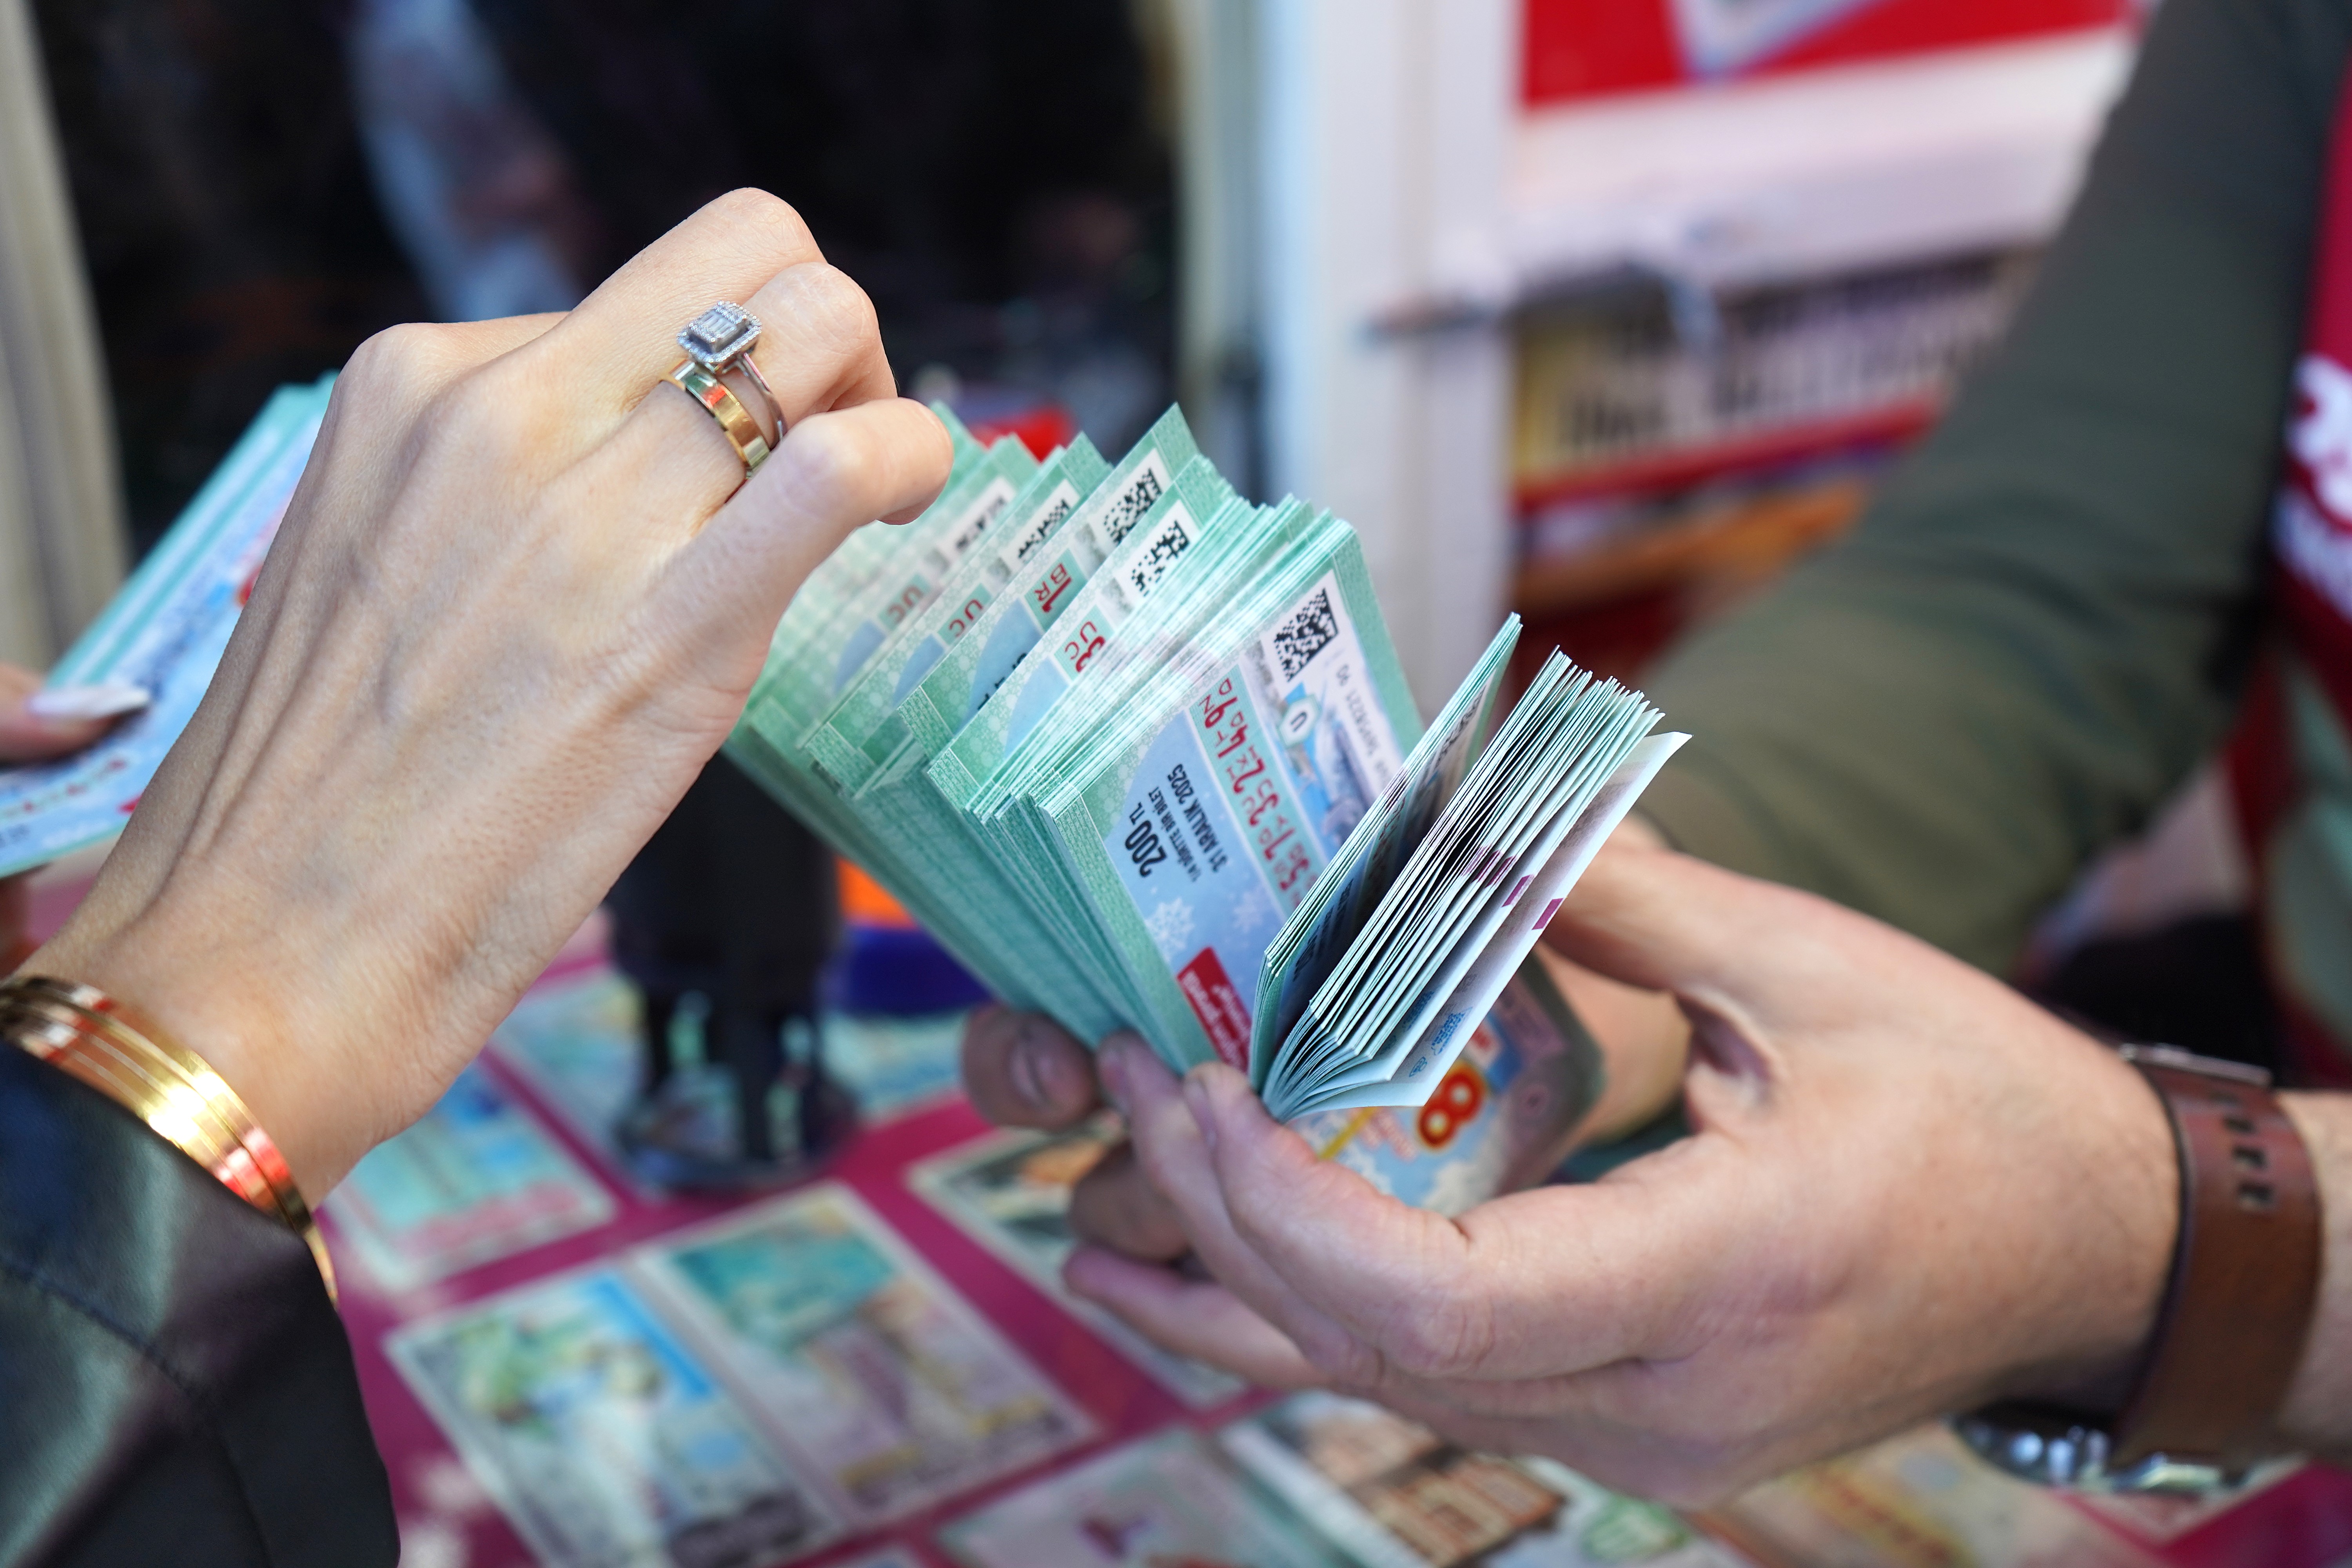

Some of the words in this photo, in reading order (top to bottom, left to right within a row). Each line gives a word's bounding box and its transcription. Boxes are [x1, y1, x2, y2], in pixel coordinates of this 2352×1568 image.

[948, 598, 985, 639] UC
[1064, 621, 1097, 660] UC
[1290, 711, 1308, 733] U
[1148, 786, 1168, 815] BİLET
[1167, 763, 1194, 804] 2025
[1129, 801, 1145, 825] TL
[1184, 799, 1219, 853] ARALIK
[1125, 820, 1167, 877] 200
[1208, 848, 1227, 873] 31
